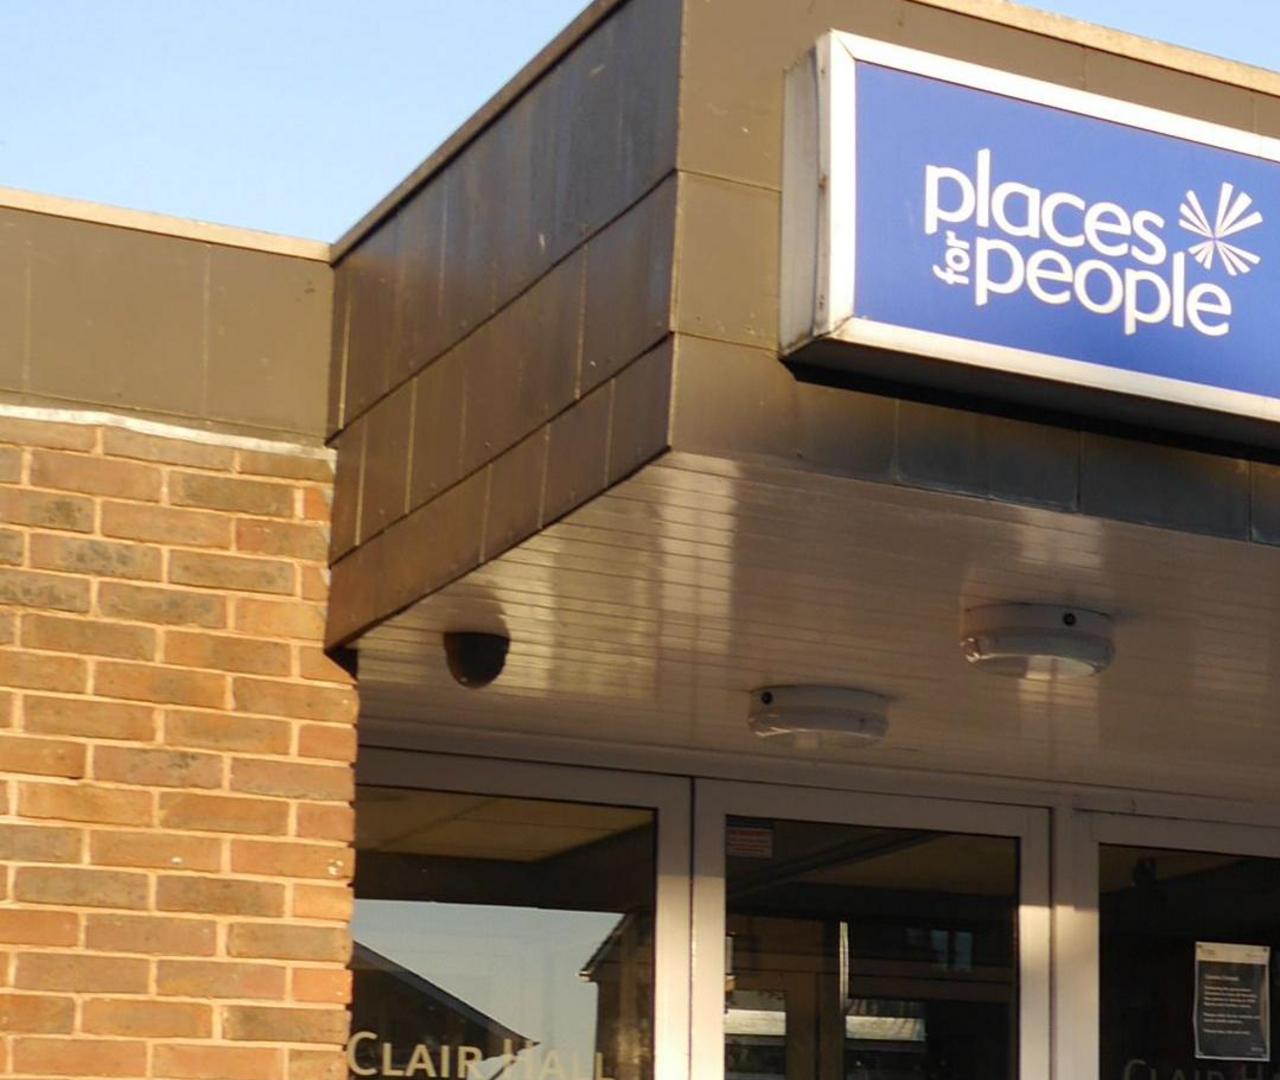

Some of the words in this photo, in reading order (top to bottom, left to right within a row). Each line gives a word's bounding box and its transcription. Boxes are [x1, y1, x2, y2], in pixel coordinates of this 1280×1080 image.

[924, 147, 1167, 264] places
[932, 230, 970, 285] for
[975, 236, 1232, 336] people
[346, 1030, 485, 1080] CLAIR
